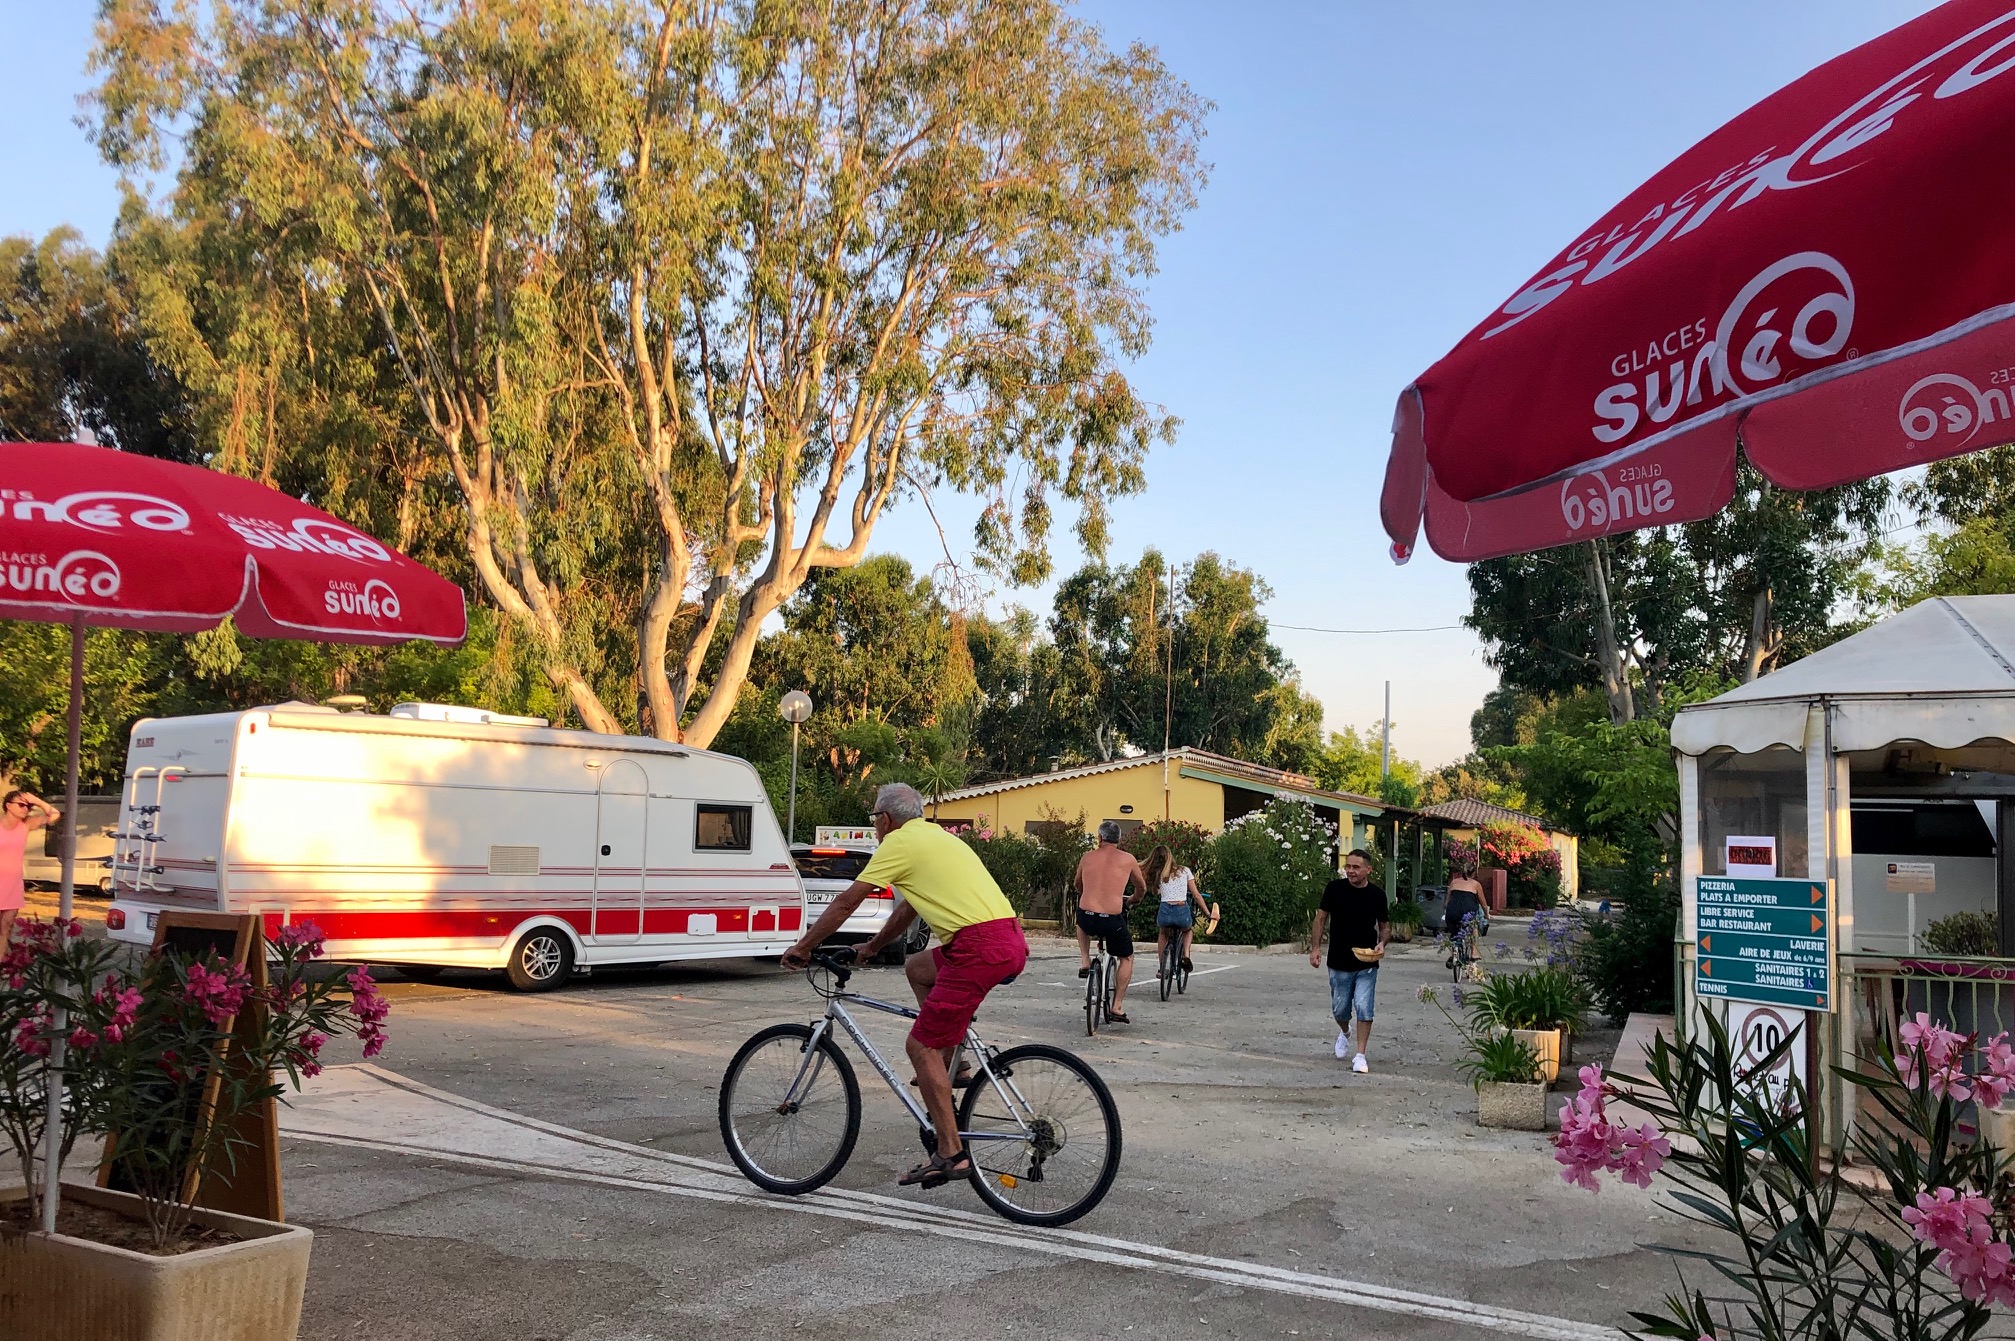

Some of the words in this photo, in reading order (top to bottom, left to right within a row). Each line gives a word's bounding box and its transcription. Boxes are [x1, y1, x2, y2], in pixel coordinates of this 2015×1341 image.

[1566, 145, 1777, 262] GLACES
[1611, 317, 1706, 377] GLACES
[0, 491, 190, 535] néo
[0, 551, 48, 566] LACES
[329, 579, 358, 593] GLACES
[1700, 881, 1736, 891] PIZZERIA
[806, 893, 823, 902] UGW
[825, 894, 839, 902] 77
[1700, 892, 1723, 902] PLATS
[1725, 893, 1731, 902] A
[1733, 893, 1778, 905] EMPORTER
[1700, 906, 1721, 917] LIBRE
[1723, 908, 1755, 919] SERVICE
[1700, 918, 1717, 928] BAR
[1719, 919, 1772, 932] RESTAURANT
[1790, 940, 1825, 952] LAVERIE
[1739, 947, 1758, 957] AIRE
[1760, 949, 1771, 959] DE
[1772, 950, 1792, 960] JEUX
[1794, 954, 1802, 962] de
[1755, 963, 1804, 977] SANITAIRES
[1806, 968, 1811, 978] 1
[1819, 969, 1825, 979] 2
[1755, 974, 1805, 988] SANITAIRES
[1699, 983, 1728, 994] TENNIS
[1755, 1023, 1780, 1054] 10
